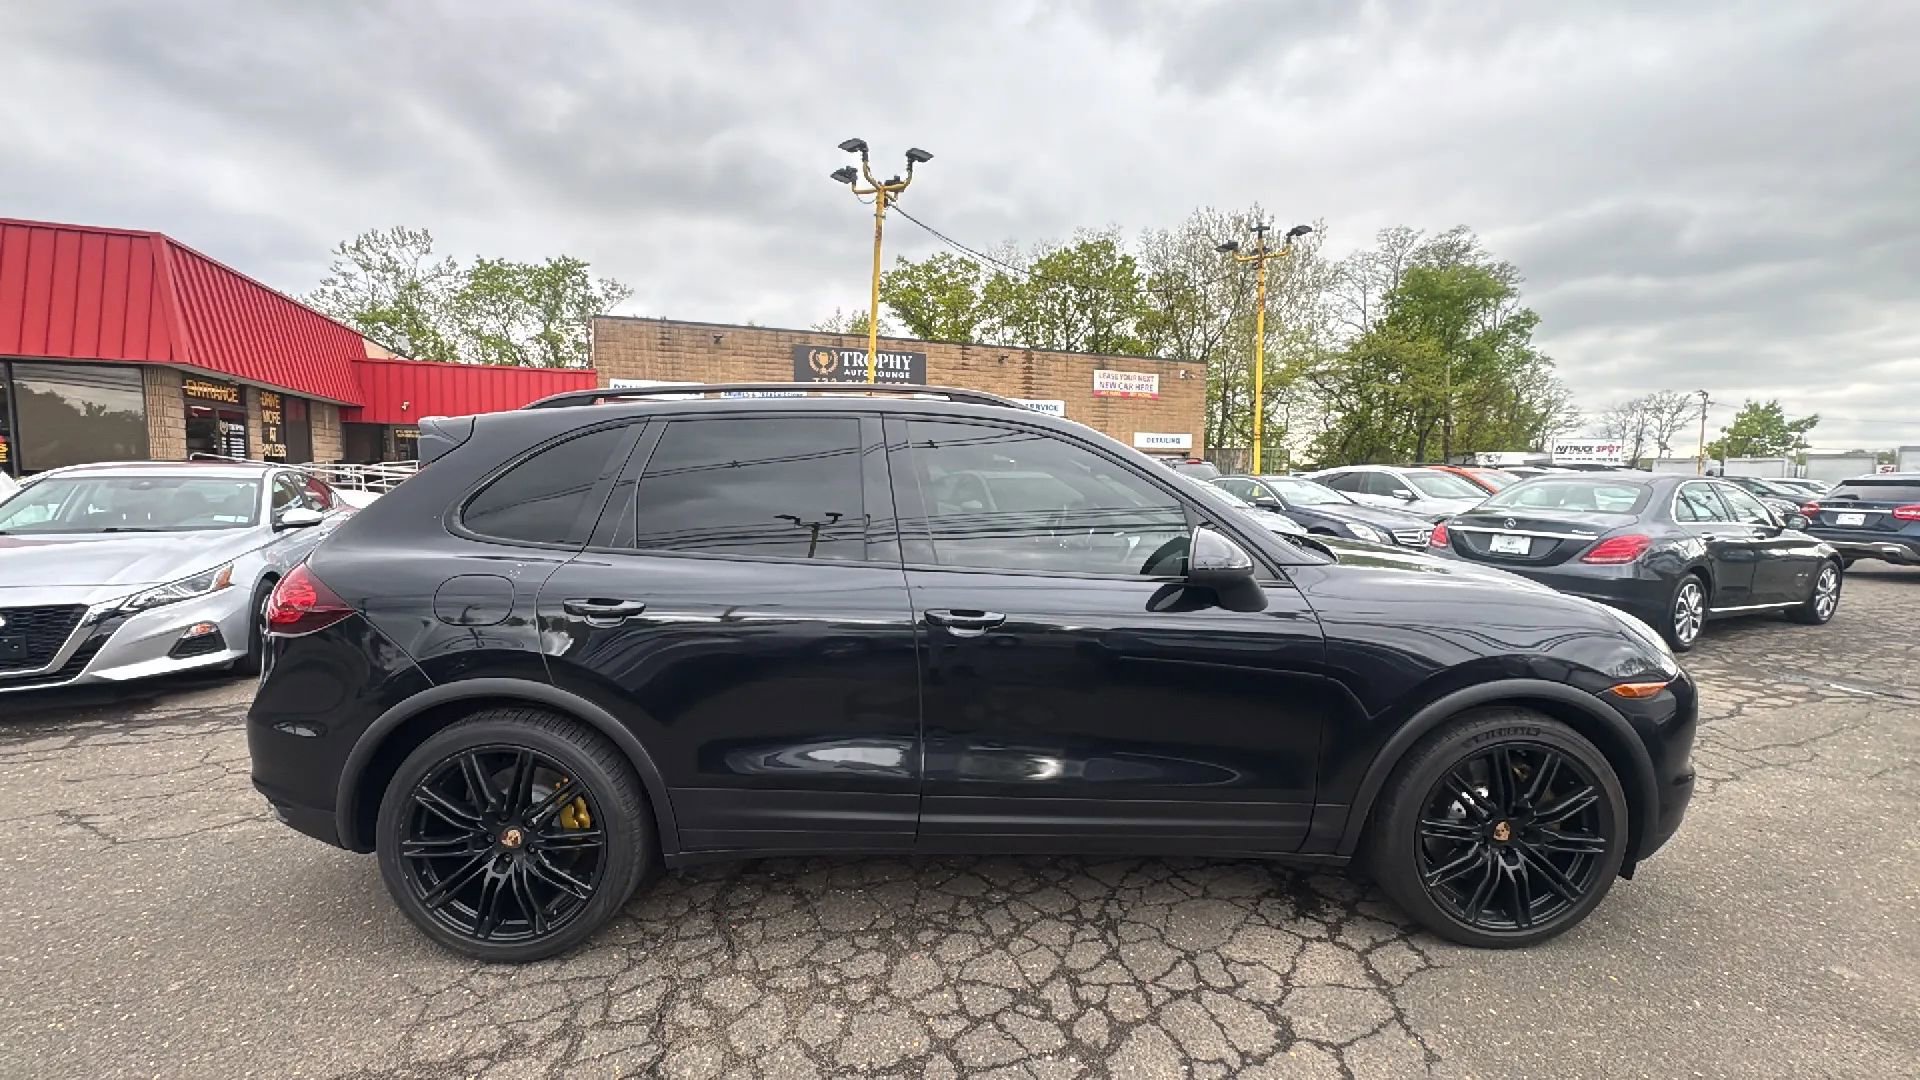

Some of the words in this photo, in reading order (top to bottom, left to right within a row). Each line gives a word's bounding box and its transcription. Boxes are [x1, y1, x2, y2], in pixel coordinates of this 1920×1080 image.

[840, 351, 913, 370] TROPHY
[1099, 372, 1118, 381] LEASE
[1119, 374, 1137, 382] YOUR
[1138, 375, 1155, 383] NEXT
[185, 379, 239, 403] ENTRANCE
[1100, 381, 1117, 389] NEW
[1118, 382, 1134, 391] CAR
[1135, 383, 1154, 392] HERE
[260, 391, 281, 409] DRIVE
[262, 409, 281, 425] MORE
[269, 427, 277, 443] AT
[1146, 437, 1181, 445] DETAILING
[261, 443, 287, 458] PAYLESS
[1569, 445, 1594, 453] TRUCK
[1596, 444, 1622, 455] SPOT
